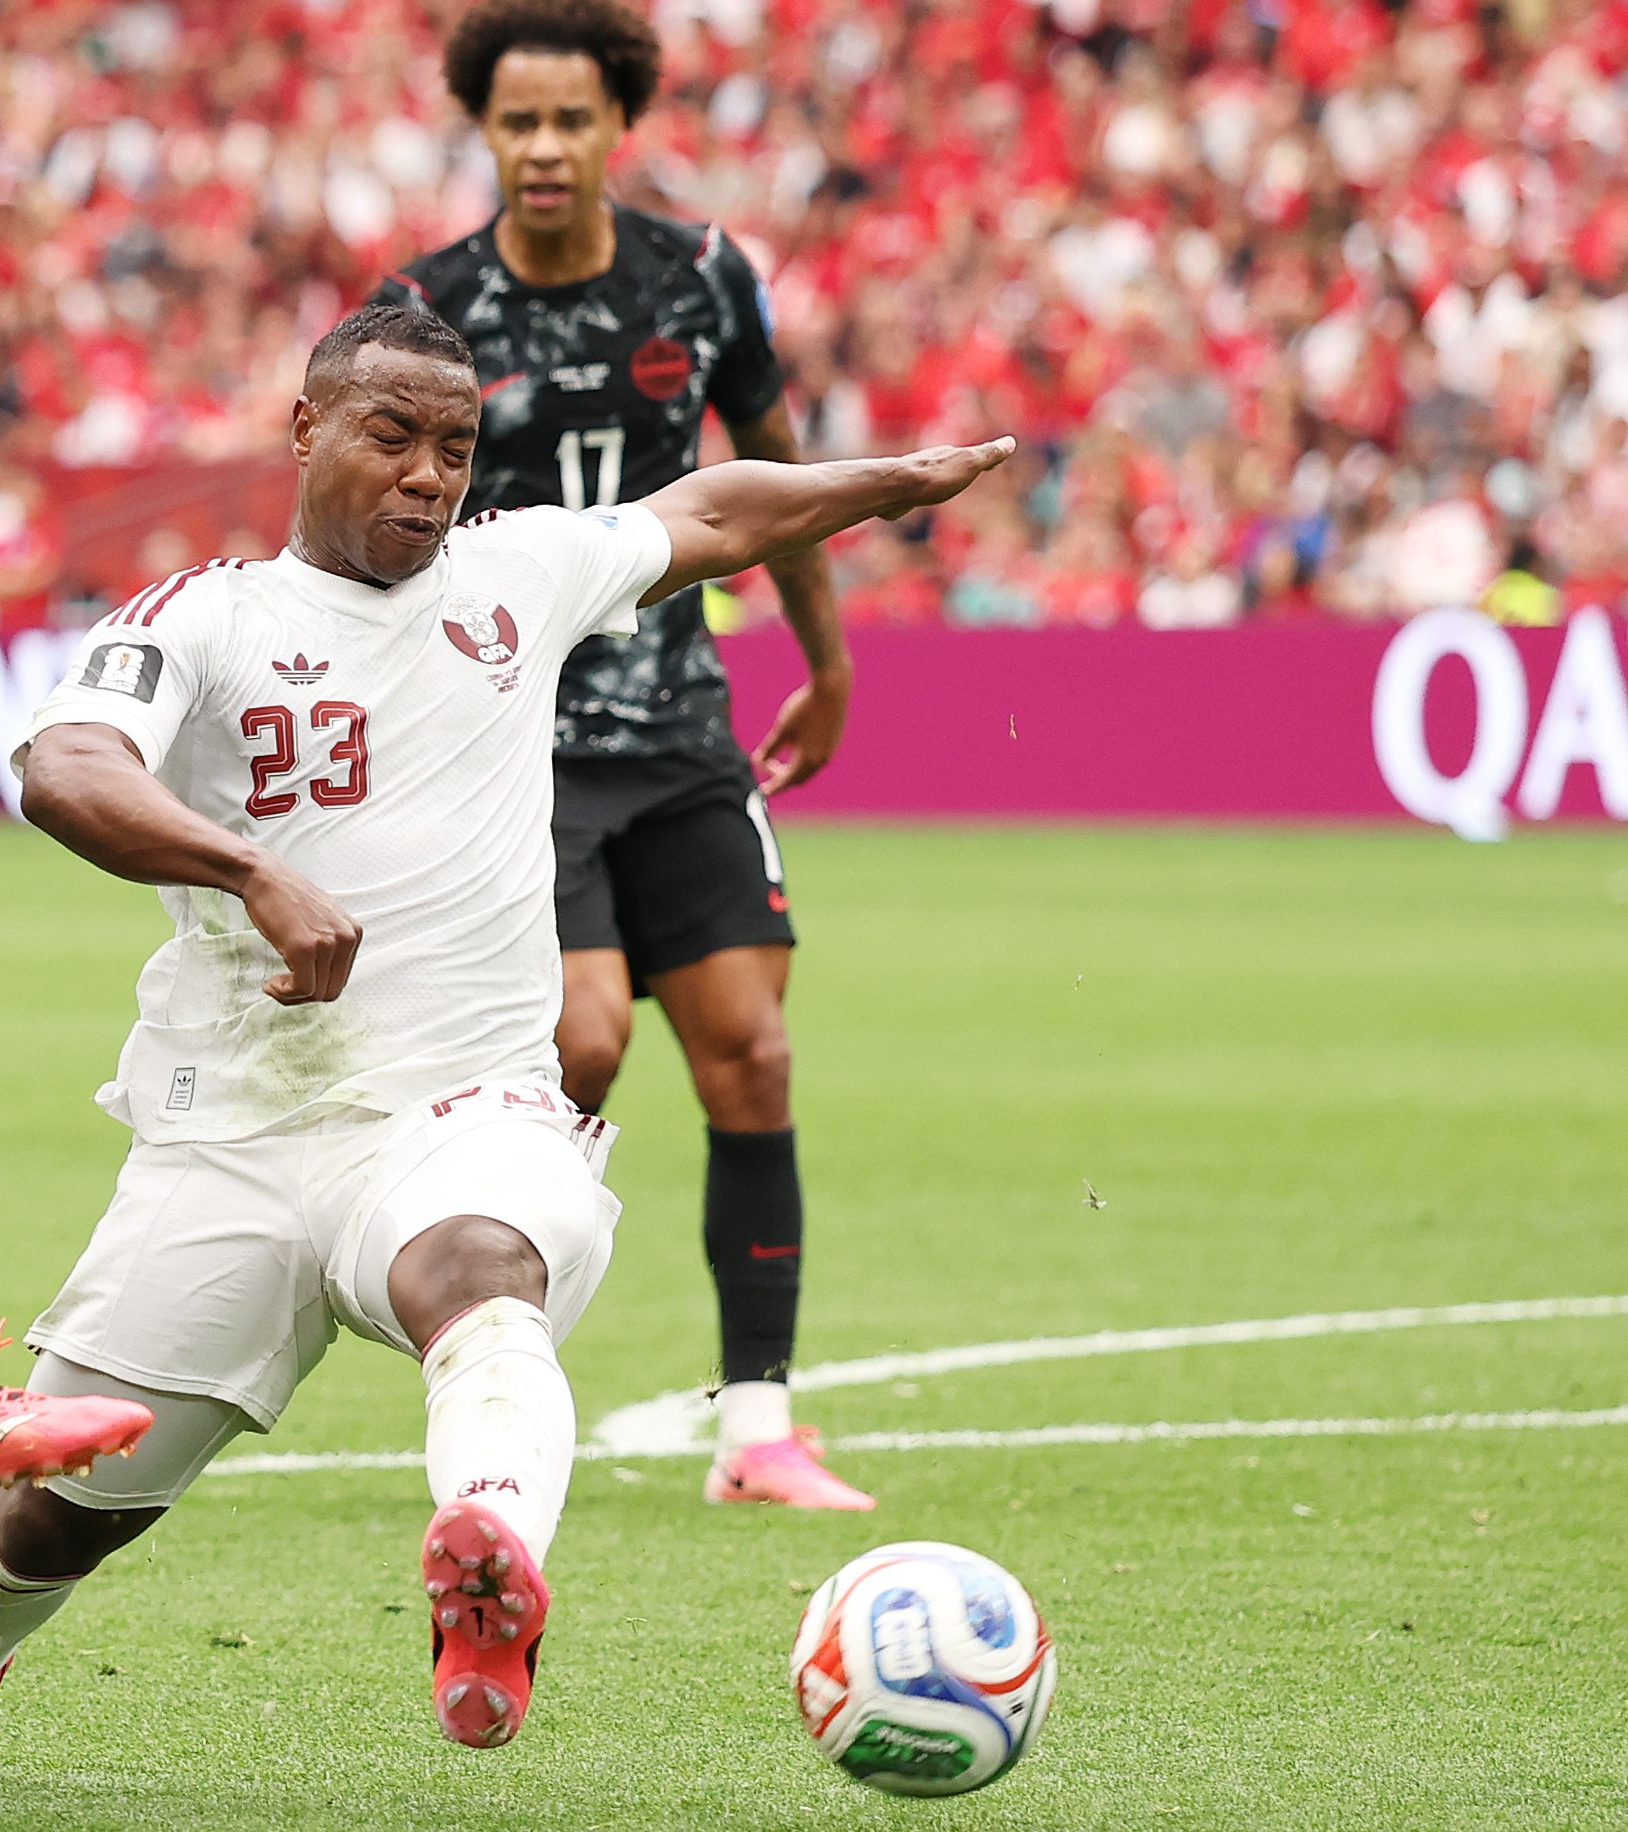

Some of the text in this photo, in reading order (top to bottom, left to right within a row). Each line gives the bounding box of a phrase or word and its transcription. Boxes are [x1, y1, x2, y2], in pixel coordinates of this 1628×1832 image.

[554, 426, 626, 512] 17
[239, 700, 371, 821] 23
[457, 1476, 521, 1498] QFA
